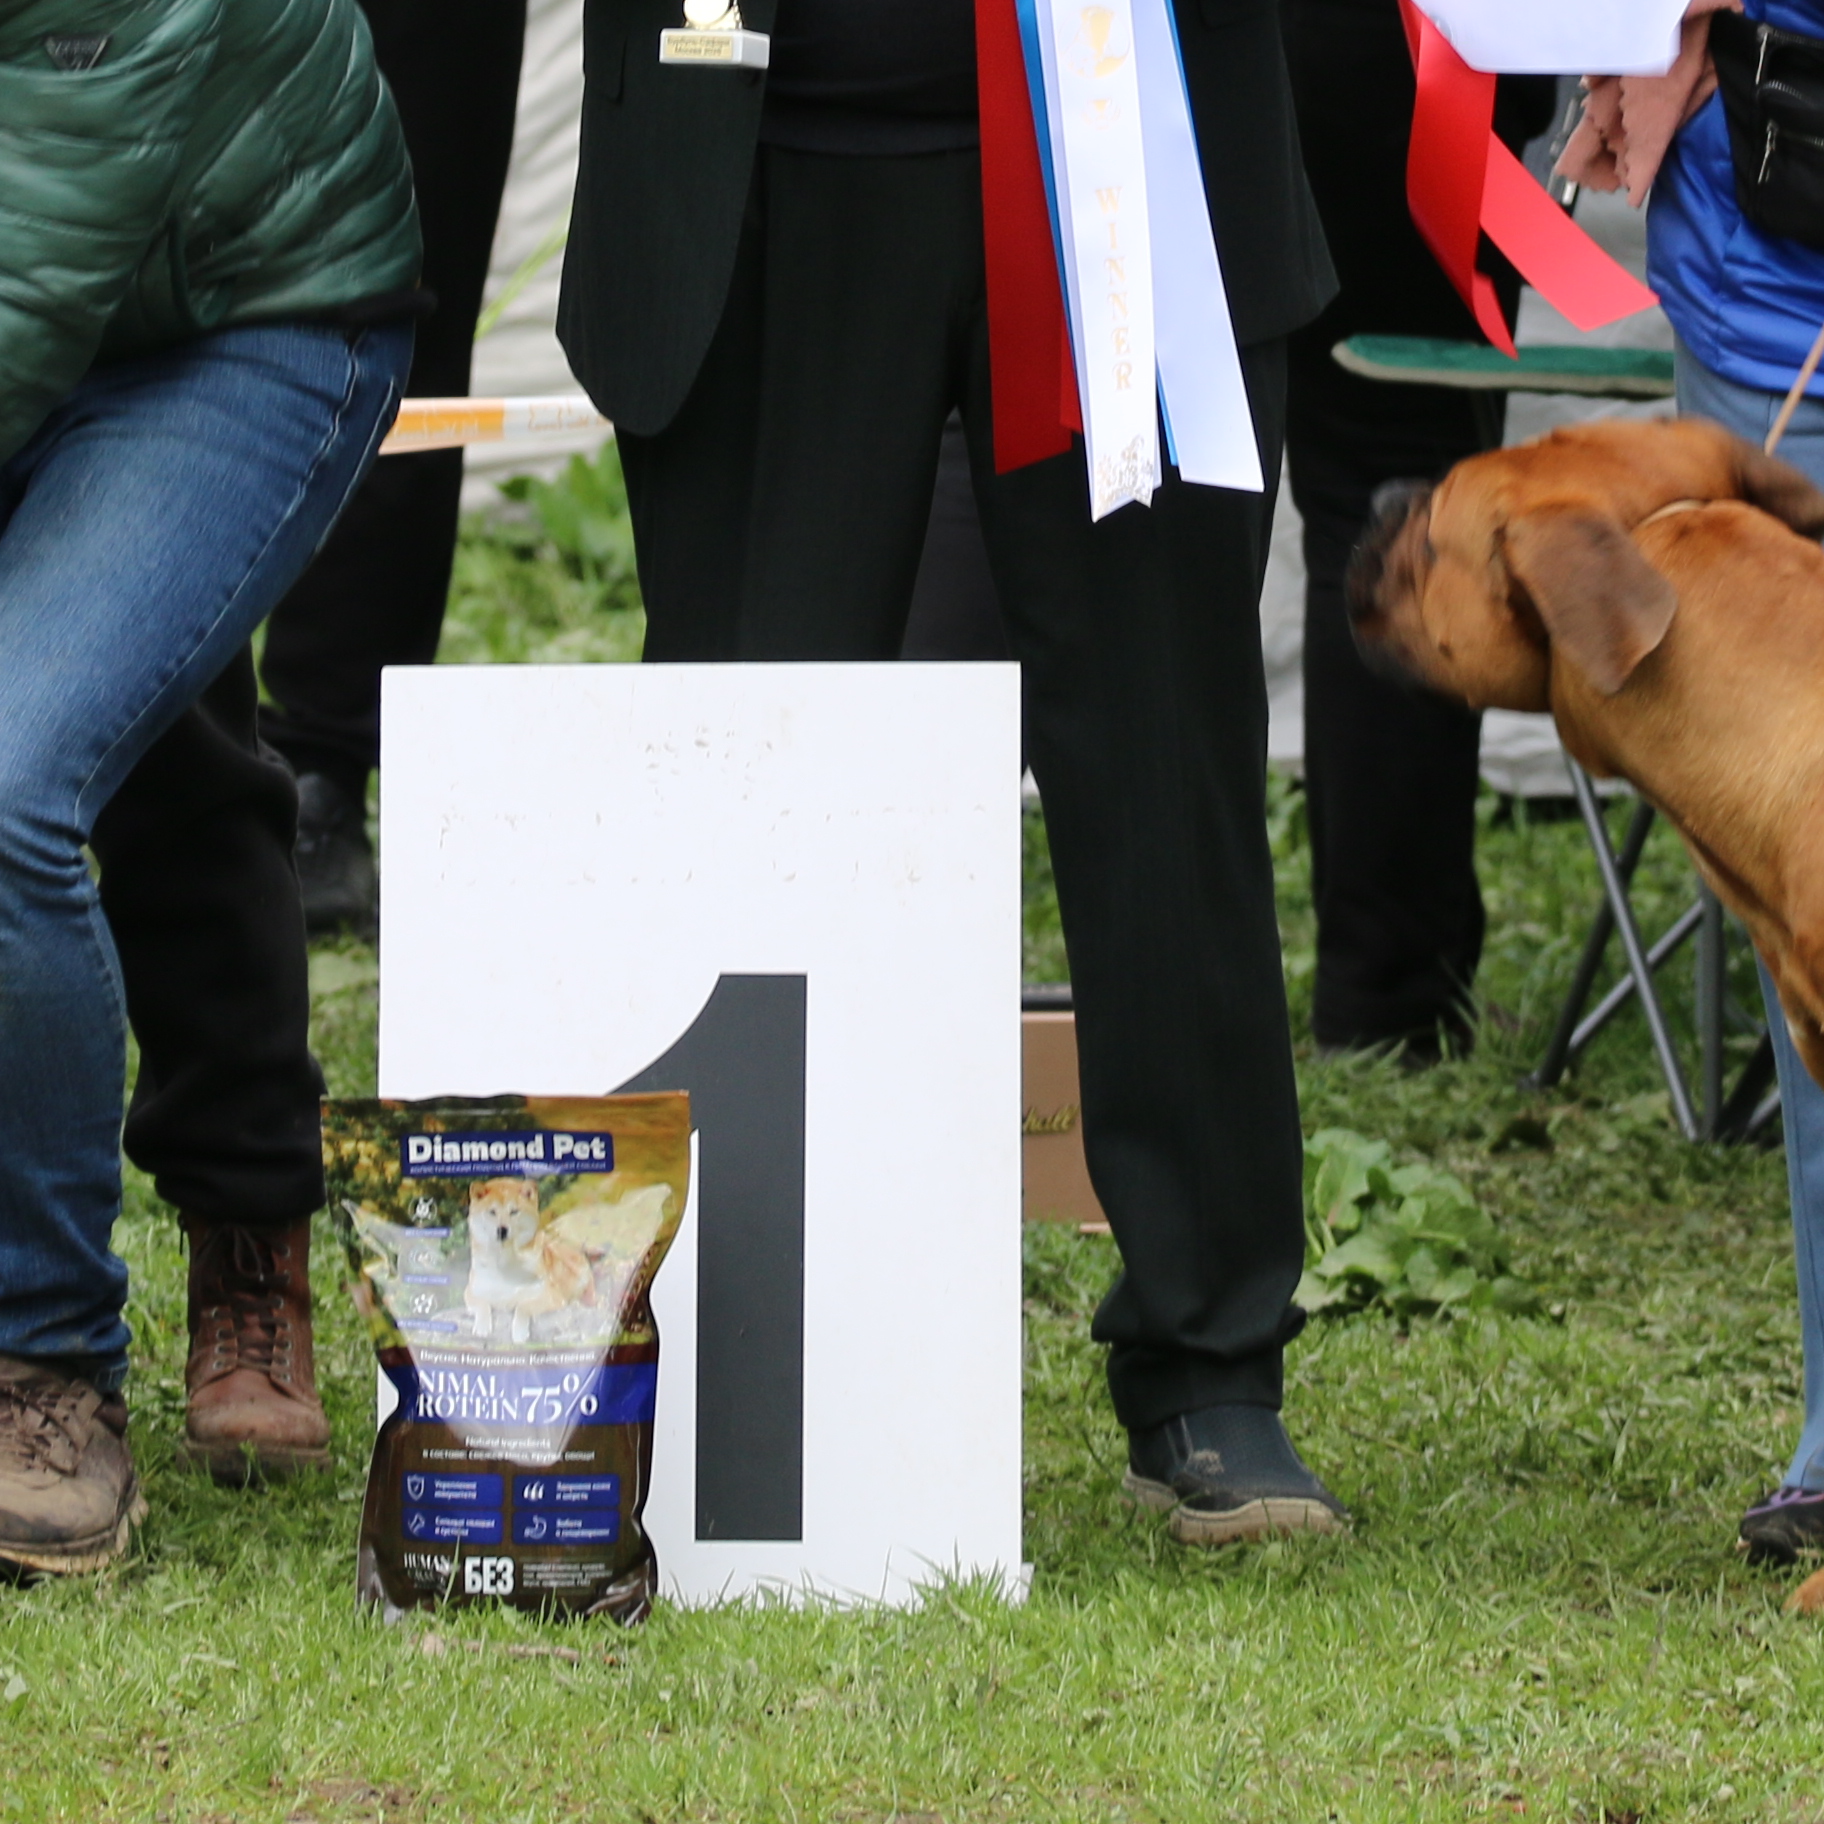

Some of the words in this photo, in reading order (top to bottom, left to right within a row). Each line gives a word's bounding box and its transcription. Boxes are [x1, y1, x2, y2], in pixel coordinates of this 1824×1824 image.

[1094, 186, 1133, 391] WINNER
[407, 1134, 544, 1164] Diamond
[553, 1133, 606, 1161] Pet
[607, 971, 808, 1541] 1
[417, 1393, 519, 1422] ROTEIN
[419, 1369, 505, 1398] NIMAL
[521, 1372, 599, 1424] 75%
[464, 1555, 515, 1596] БЕЗ
